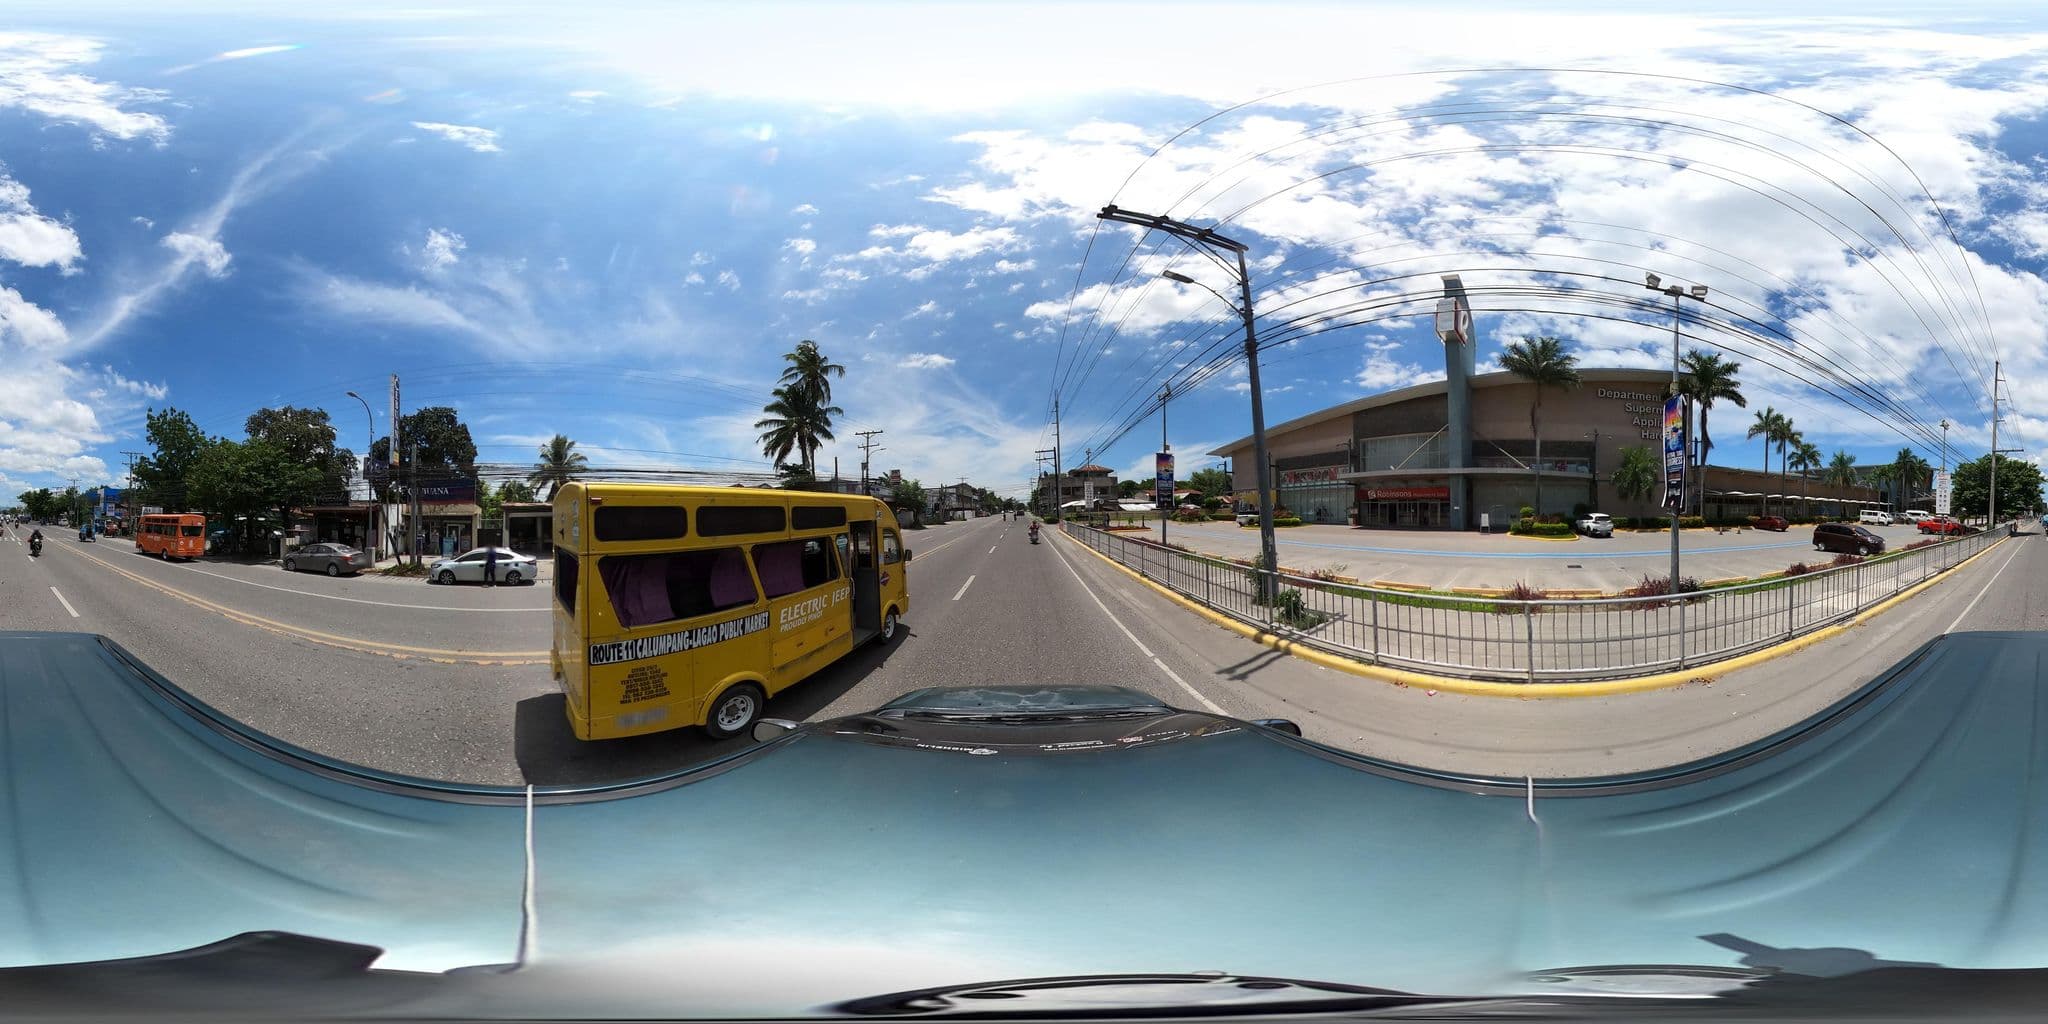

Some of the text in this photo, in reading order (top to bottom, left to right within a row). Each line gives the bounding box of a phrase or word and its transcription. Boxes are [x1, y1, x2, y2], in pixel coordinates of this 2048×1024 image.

[1597, 388, 1662, 402] Department
[780, 586, 850, 623] ELECTRIC JEEP
[592, 643, 624, 663] ROUTE
[636, 623, 718, 659] CALUMPANG-LAGAO
[719, 615, 744, 641] PUBLIC
[744, 612, 769, 635] MARKET
